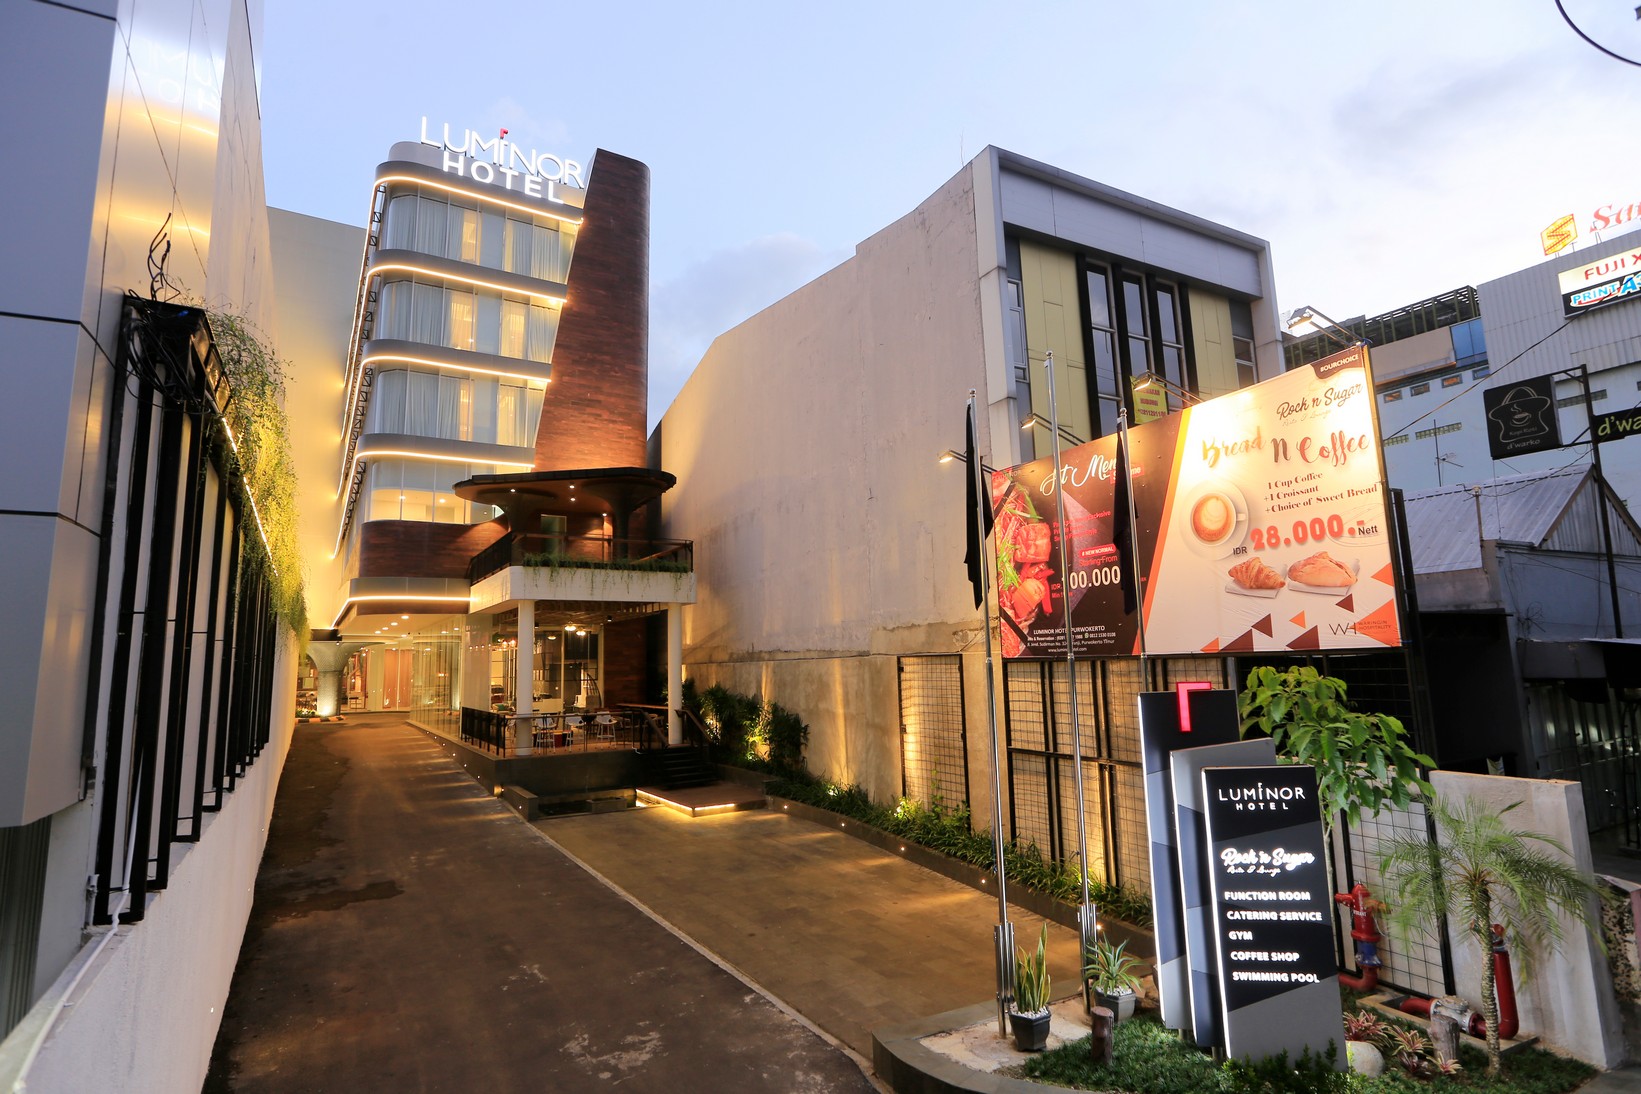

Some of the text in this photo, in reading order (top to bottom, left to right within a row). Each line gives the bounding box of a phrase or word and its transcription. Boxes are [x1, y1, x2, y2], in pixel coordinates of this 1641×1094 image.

[420, 116, 584, 188] LUMINOR
[443, 152, 564, 204] HOTEL
[1590, 201, 1641, 234] Sa
[1584, 258, 1626, 280] FUJI
[1572, 283, 1618, 304] PRINT
[1320, 354, 1359, 372] #OURCHOICE
[1276, 397, 1309, 420] Rock
[1324, 384, 1363, 407] Sugar
[1202, 426, 1266, 468] Bread
[1296, 430, 1370, 467] Coffee
[1274, 479, 1292, 488] Cup
[1294, 472, 1322, 484] Coffee
[1276, 485, 1319, 500] Croissant
[1302, 498, 1312, 506] of
[1316, 492, 1344, 503] Sweet
[1347, 484, 1378, 498] Bread
[1232, 546, 1248, 555] IDR
[1358, 525, 1378, 536] Nett
[1096, 546, 1114, 554] NORMAL
[1102, 555, 1118, 563] From
[1062, 566, 1120, 589] 00.000
[1218, 782, 1306, 800] LUMINOR
[1221, 848, 1258, 866] Rock
[1272, 848, 1315, 870] Sugar
[1224, 892, 1311, 900] FUNCTION ROOM
[1226, 911, 1322, 920] CATERING SERVICE
[1228, 931, 1253, 940] GYM
[1230, 951, 1300, 961] COFFEE SHOP
[1232, 972, 1320, 983] SWIMMING POOL
